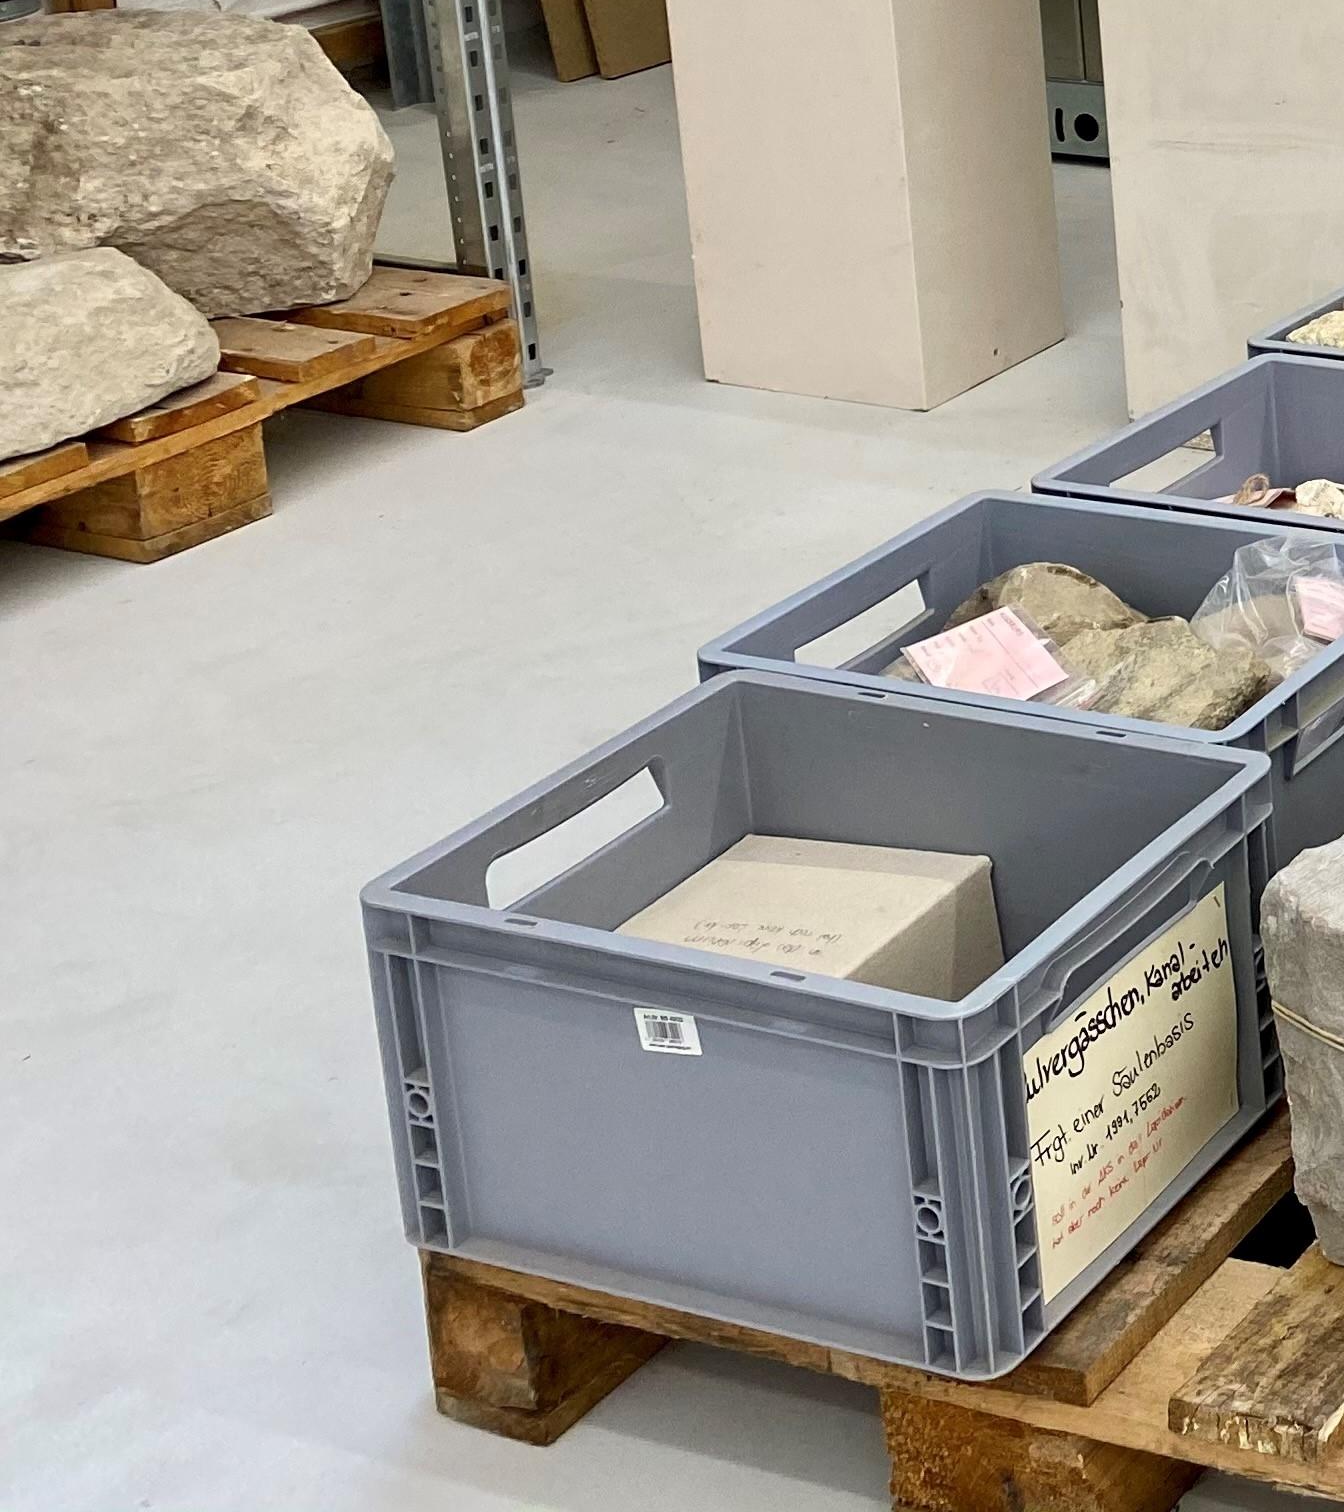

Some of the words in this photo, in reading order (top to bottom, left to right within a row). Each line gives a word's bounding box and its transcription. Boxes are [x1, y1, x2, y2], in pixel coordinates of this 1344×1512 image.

[1171, 937, 1229, 1002] arbeiten
[1072, 1095, 1105, 1134] einer
[1111, 1011, 1195, 1098] Säulenbasis
